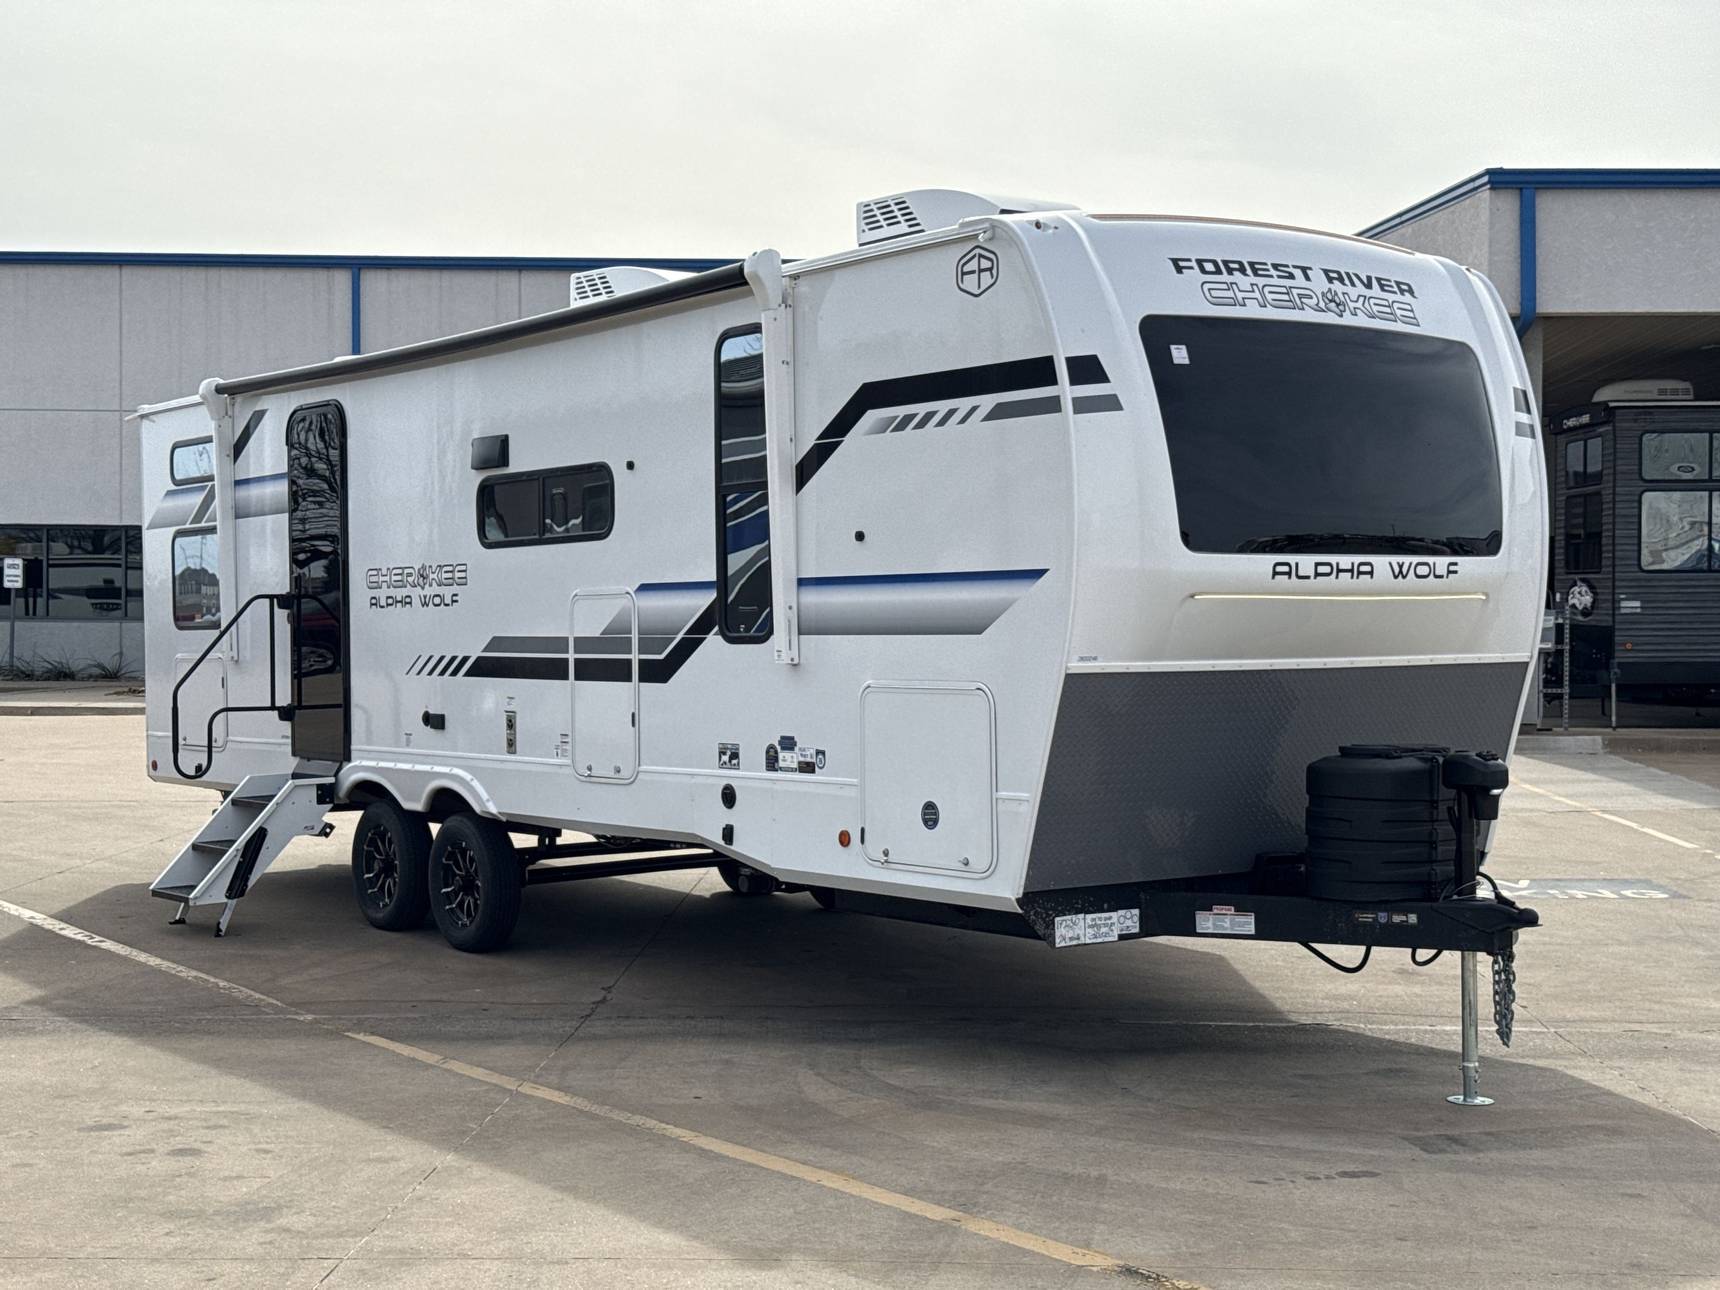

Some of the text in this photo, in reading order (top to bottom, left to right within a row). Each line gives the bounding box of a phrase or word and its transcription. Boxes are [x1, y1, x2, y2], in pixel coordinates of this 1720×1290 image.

[1167, 257, 1419, 299] FOREST RIVER
[1200, 280, 1421, 328] CHEROKEE
[366, 563, 468, 590] CHEROKEE
[1271, 561, 1459, 580] ALPHA WOLF
[369, 593, 459, 609] ALPHA WOLF
